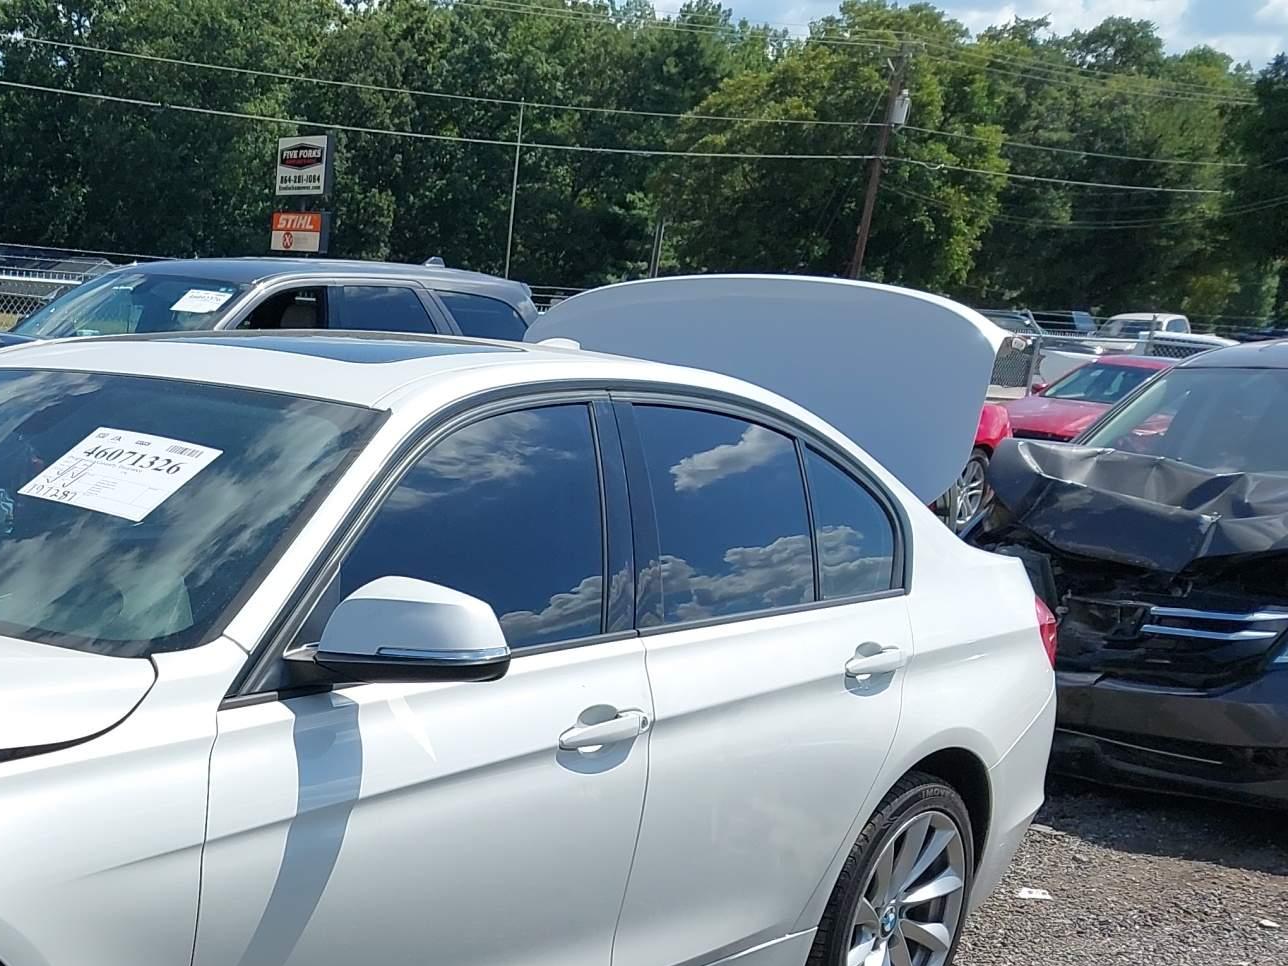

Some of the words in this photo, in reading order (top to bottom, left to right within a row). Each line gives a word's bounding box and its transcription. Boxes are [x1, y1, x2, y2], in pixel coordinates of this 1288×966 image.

[282, 150, 298, 159] FIVE
[298, 149, 321, 159] FORKS
[277, 214, 314, 229] STIHL
[83, 445, 188, 475] 46071326
